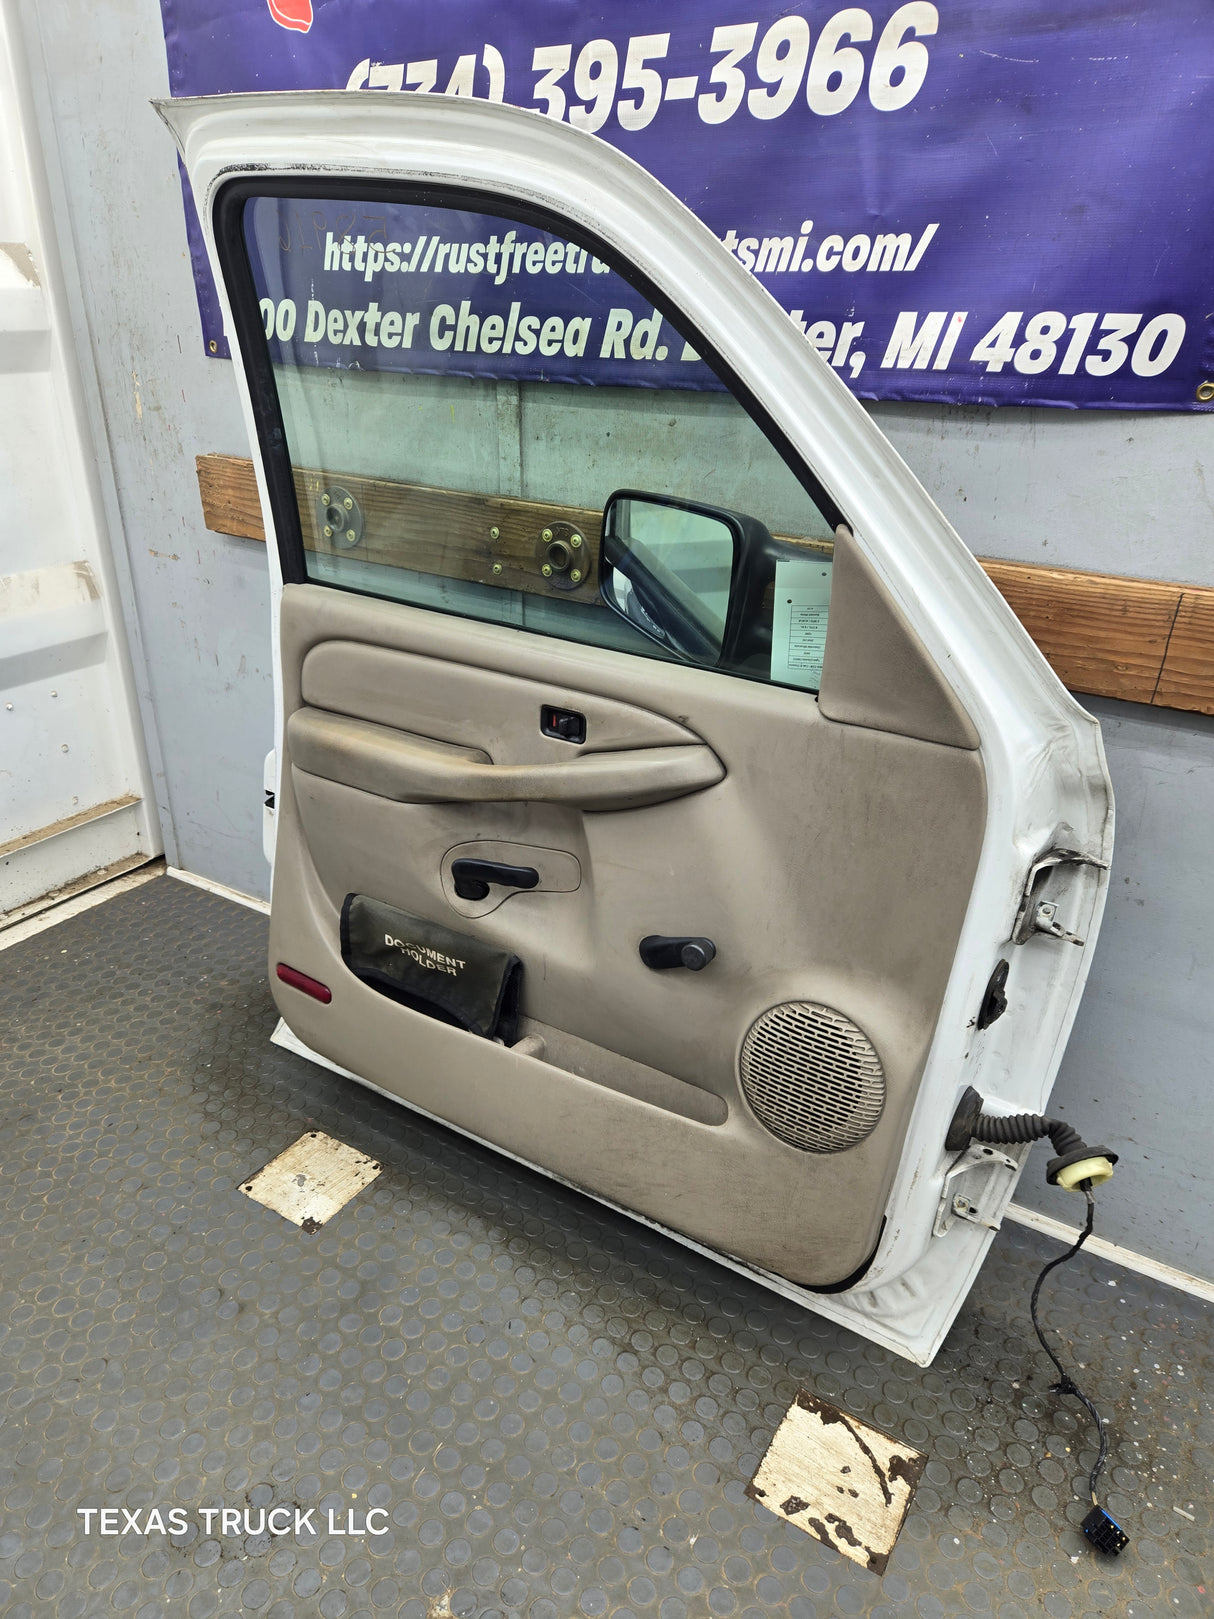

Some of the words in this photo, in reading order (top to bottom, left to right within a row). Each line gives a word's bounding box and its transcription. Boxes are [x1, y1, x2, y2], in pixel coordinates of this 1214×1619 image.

[530, 1, 939, 135] 395-3966
[304, 300, 420, 349] Dexter
[430, 301, 592, 358] Chelsea
[599, 308, 668, 361] Rd.
[880, 311, 968, 370] MI
[970, 311, 1187, 377] 48130
[384, 933, 466, 970] DOCUMENT
[401, 947, 457, 977] HOLDER
